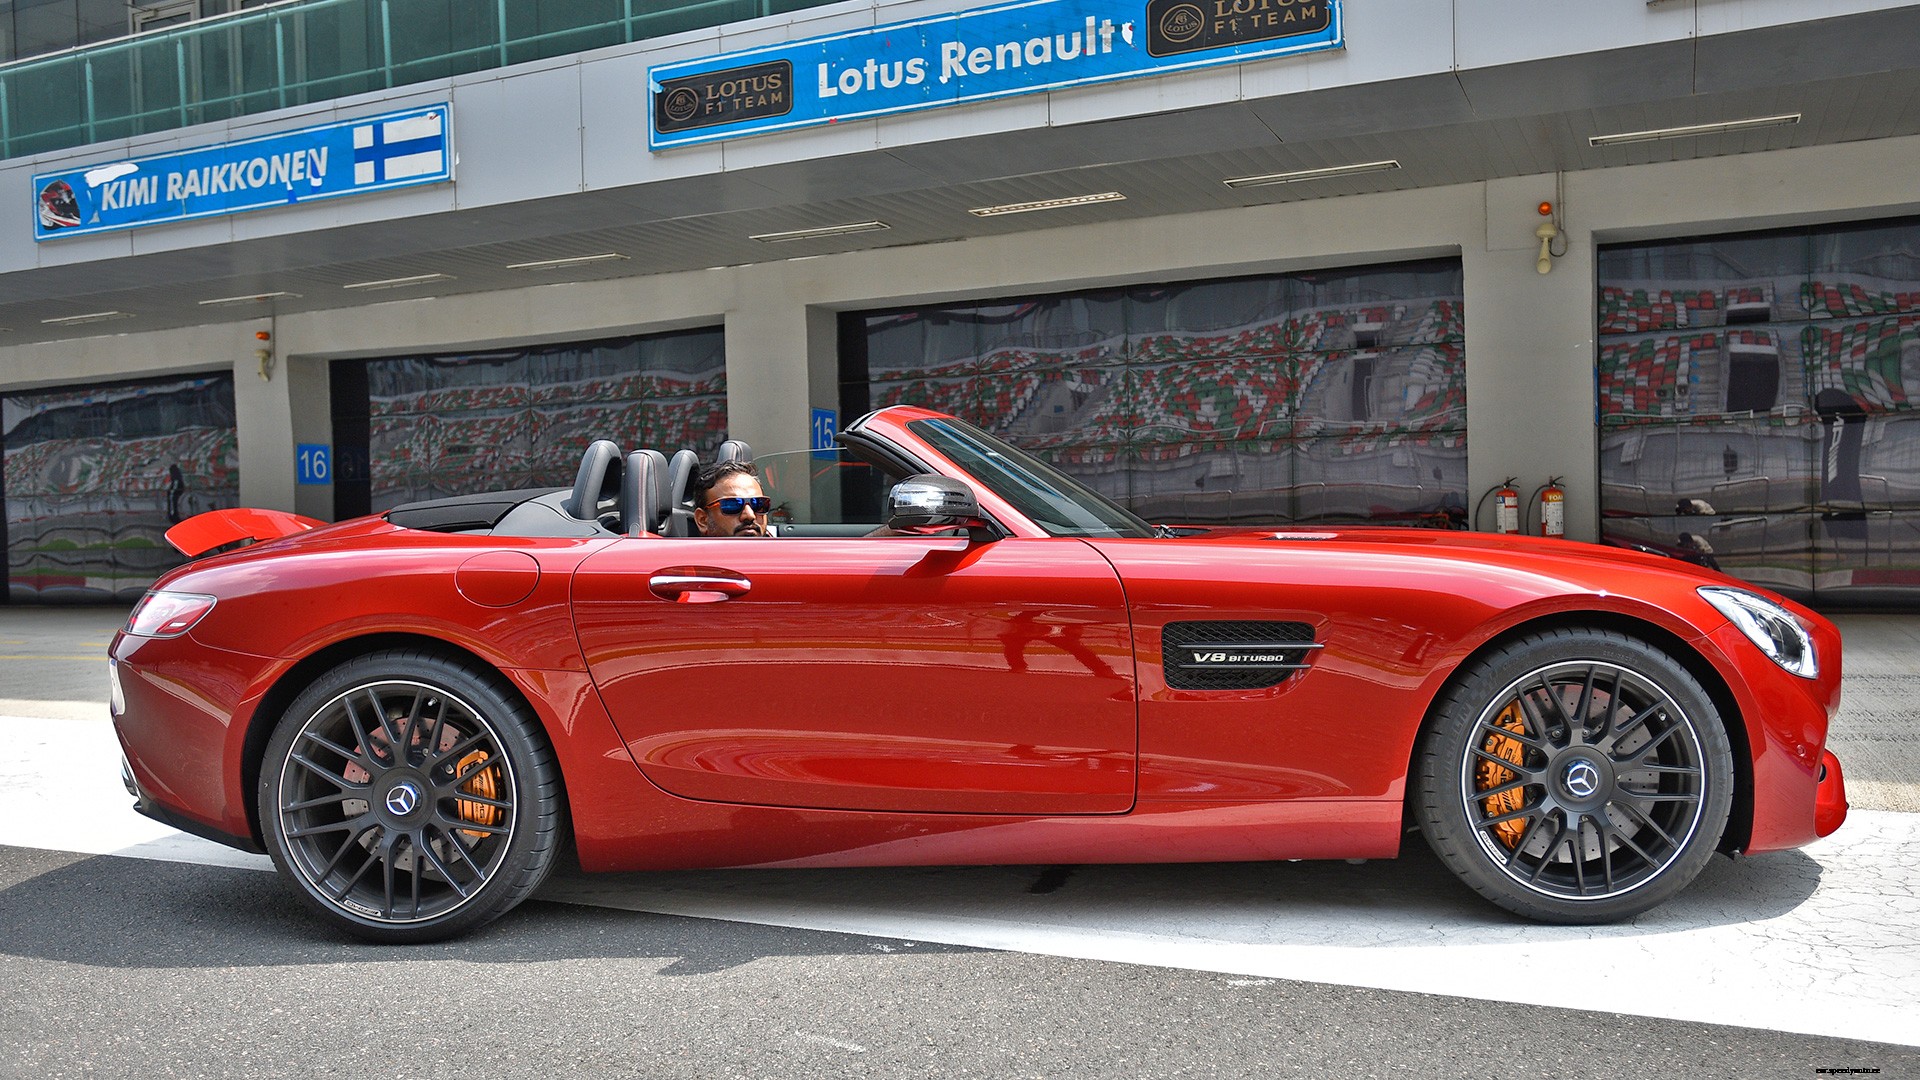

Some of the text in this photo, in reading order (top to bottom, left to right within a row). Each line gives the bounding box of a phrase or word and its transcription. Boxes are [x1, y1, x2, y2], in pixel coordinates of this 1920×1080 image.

[1214, 0, 1311, 17] LOT
[1214, 5, 1316, 34] F1 TEAM
[817, 15, 1115, 98] Lotus Renault
[705, 73, 782, 100] LOTUS
[705, 91, 783, 115] F1 TEAM
[102, 146, 329, 211] KIMI RAIKKONEN
[814, 415, 834, 449] 15
[301, 449, 327, 479] 16
[1193, 652, 1284, 663] V8 BITURBO
